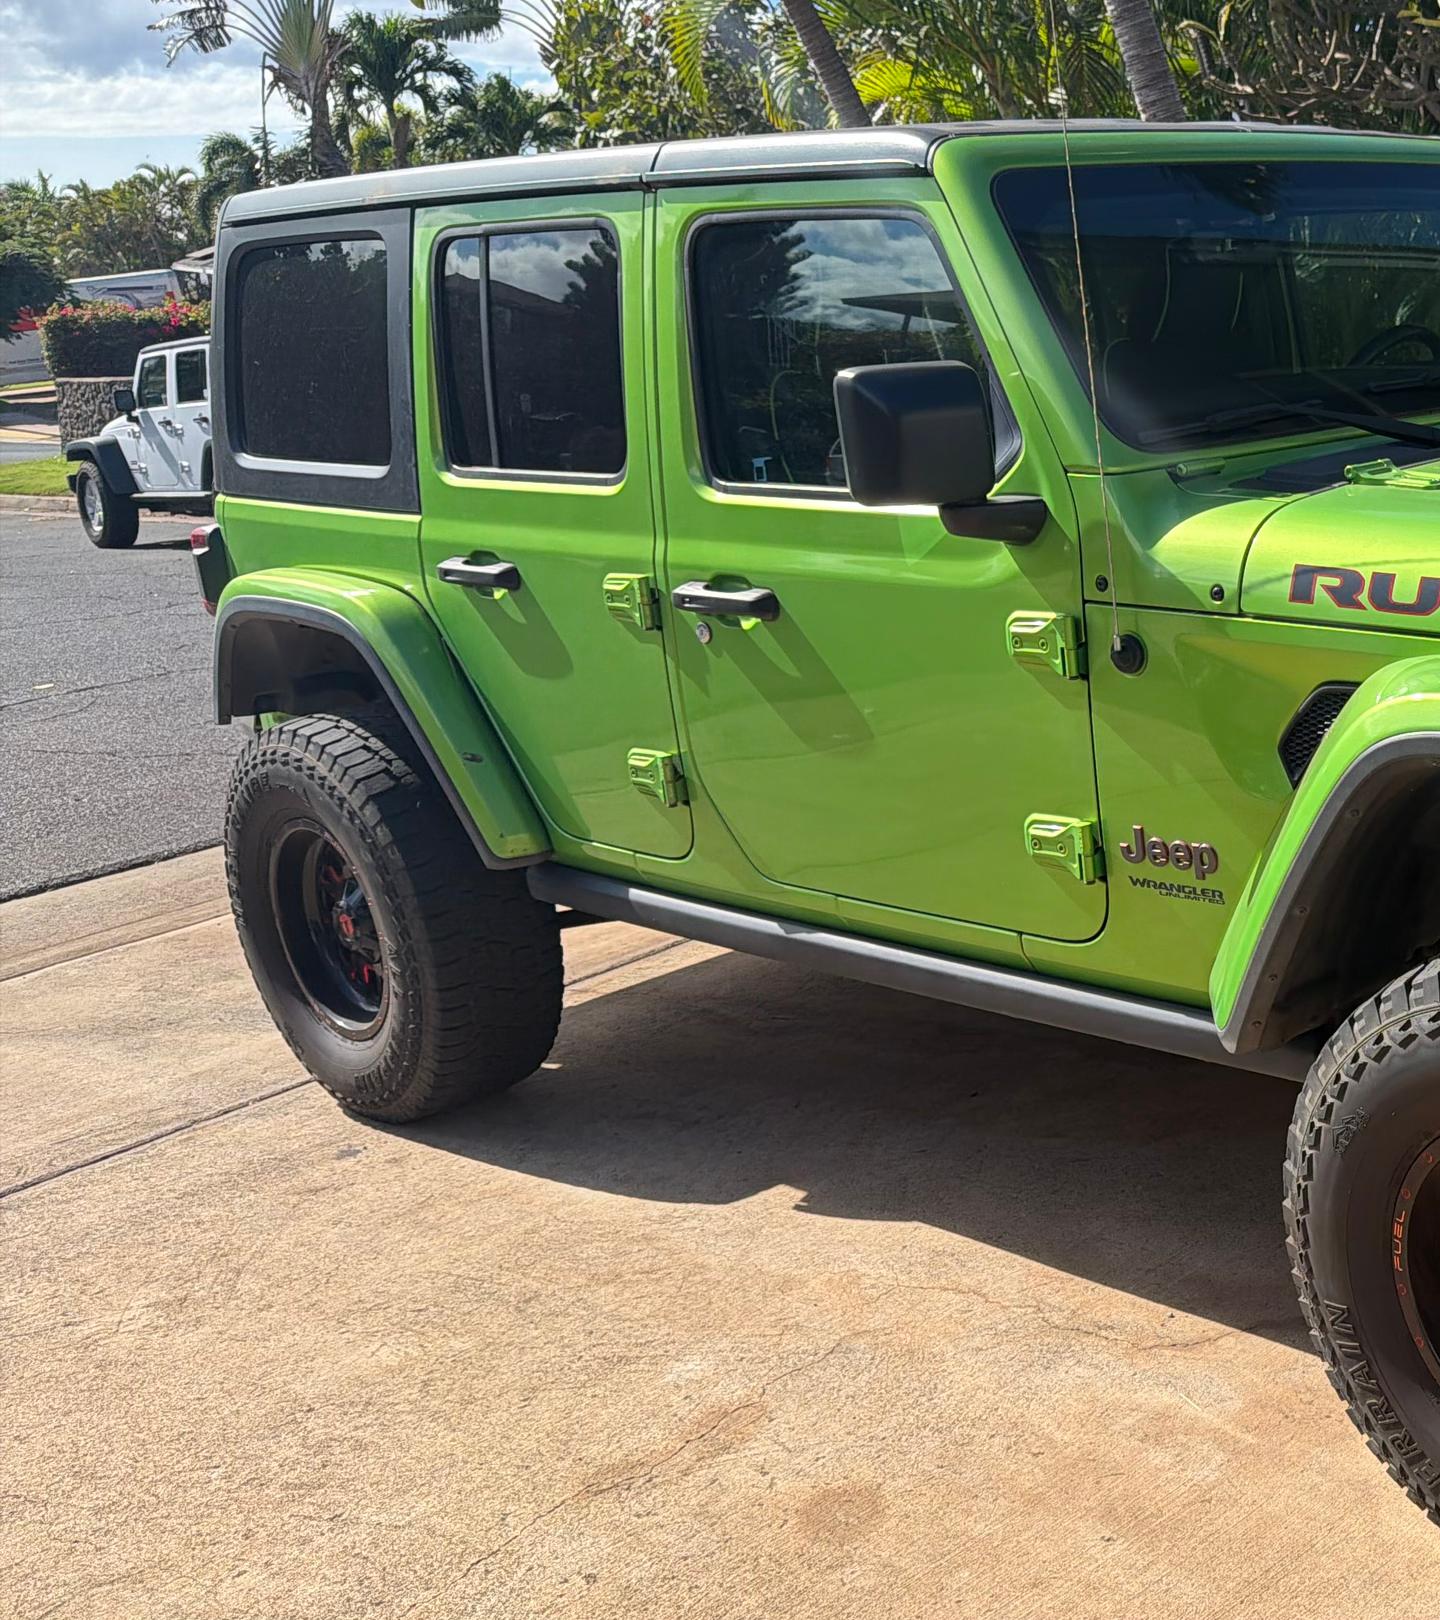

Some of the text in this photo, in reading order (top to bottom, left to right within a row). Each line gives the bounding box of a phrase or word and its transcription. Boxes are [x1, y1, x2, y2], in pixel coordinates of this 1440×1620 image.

[1120, 825, 1219, 881] Jeep
[1128, 875, 1224, 900] WRANGLER
[1159, 890, 1226, 905] UNLIMITED
[1393, 1210, 1406, 1272] FUEL
